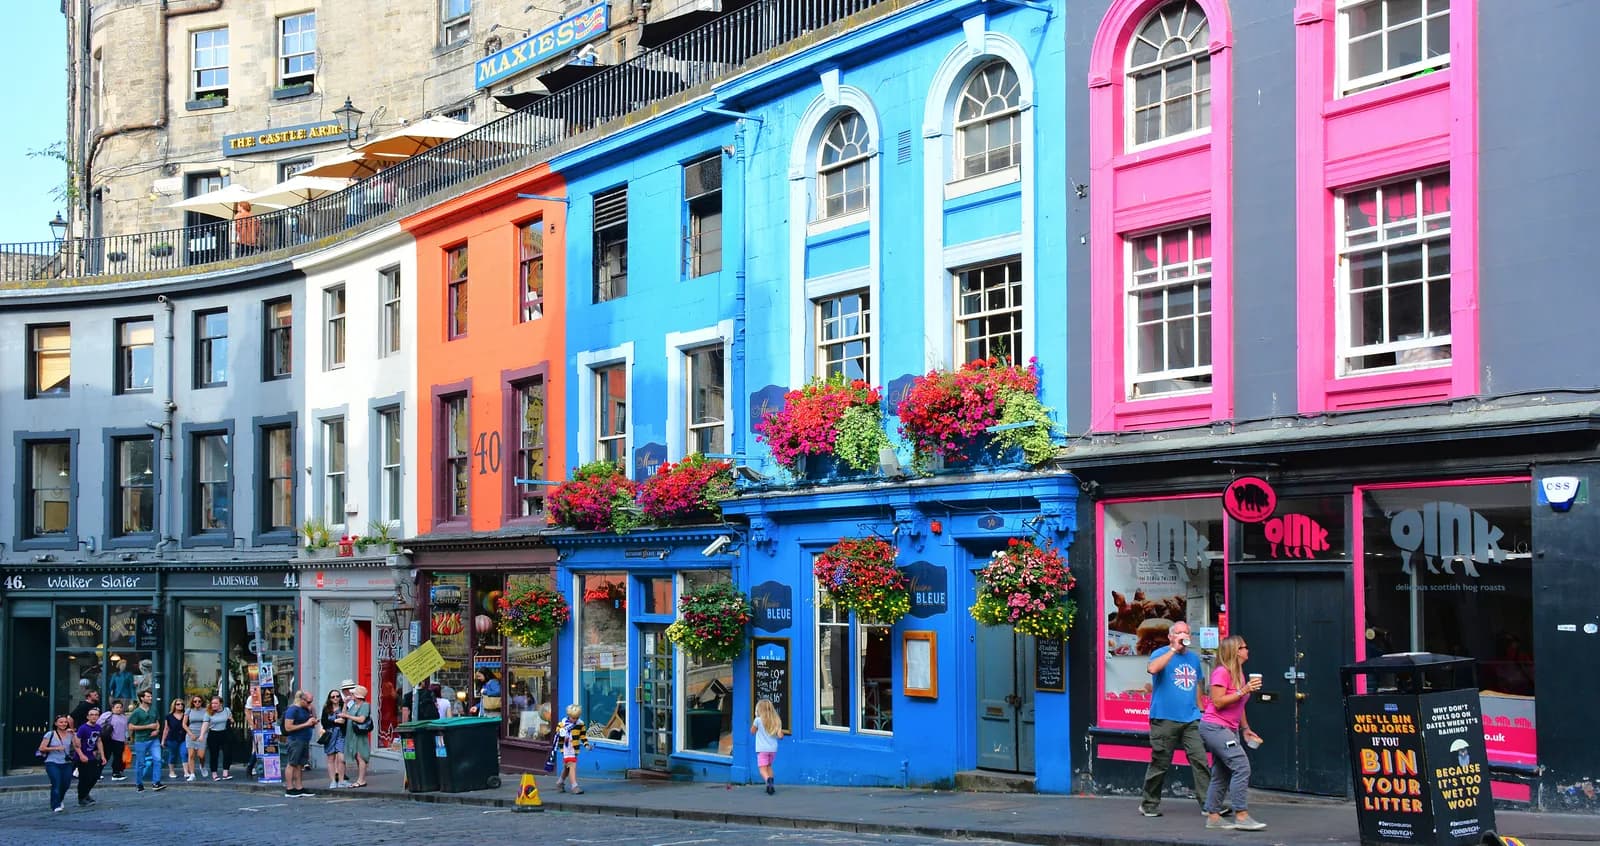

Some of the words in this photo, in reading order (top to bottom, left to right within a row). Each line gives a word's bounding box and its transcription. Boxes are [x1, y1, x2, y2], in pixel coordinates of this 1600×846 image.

[479, 21, 574, 81] MAXIES
[229, 138, 256, 149] THE
[258, 131, 307, 145] CASTLE
[308, 124, 344, 139] ARM
[474, 431, 501, 475] 40
[1546, 482, 1570, 491] CSS
[1264, 514, 1330, 554] oink
[4, 574, 26, 589] 46.
[47, 575, 93, 588] Walker
[101, 574, 141, 588] Slater
[212, 575, 259, 586] LADIESWEAR
[283, 572, 299, 587] 44.
[1430, 583, 1461, 591] scottish
[1463, 583, 1478, 592] hog
[916, 592, 945, 604] BLEUE
[767, 608, 791, 620] BLEUE
[1123, 708, 1150, 716] www.oi
[1432, 706, 1447, 714] WHY
[1448, 704, 1468, 712] DON'T
[1355, 714, 1389, 724] WE'LL
[1391, 714, 1412, 724] BIN
[1426, 721, 1446, 730] DATES
[1446, 719, 1465, 727] WHEN
[1466, 717, 1478, 725] IT'S
[1431, 713, 1450, 721] OWLS
[1353, 724, 1378, 733] OUR
[1380, 724, 1416, 734] JOKES
[1438, 726, 1468, 735] RAINING?
[1372, 737, 1380, 746] IF
[1381, 737, 1399, 747] YOU
[1484, 733, 1505, 742] o.uk
[1360, 748, 1418, 776] BIN
[1435, 763, 1481, 778] BECAUSE
[1362, 777, 1421, 796] YOUR
[1438, 778, 1458, 789] IT'S
[1460, 774, 1481, 786] TOO
[1442, 788, 1463, 800] WET
[1466, 786, 1480, 796] TO
[1364, 796, 1424, 813] LITTER
[1448, 797, 1477, 810] WOO!
